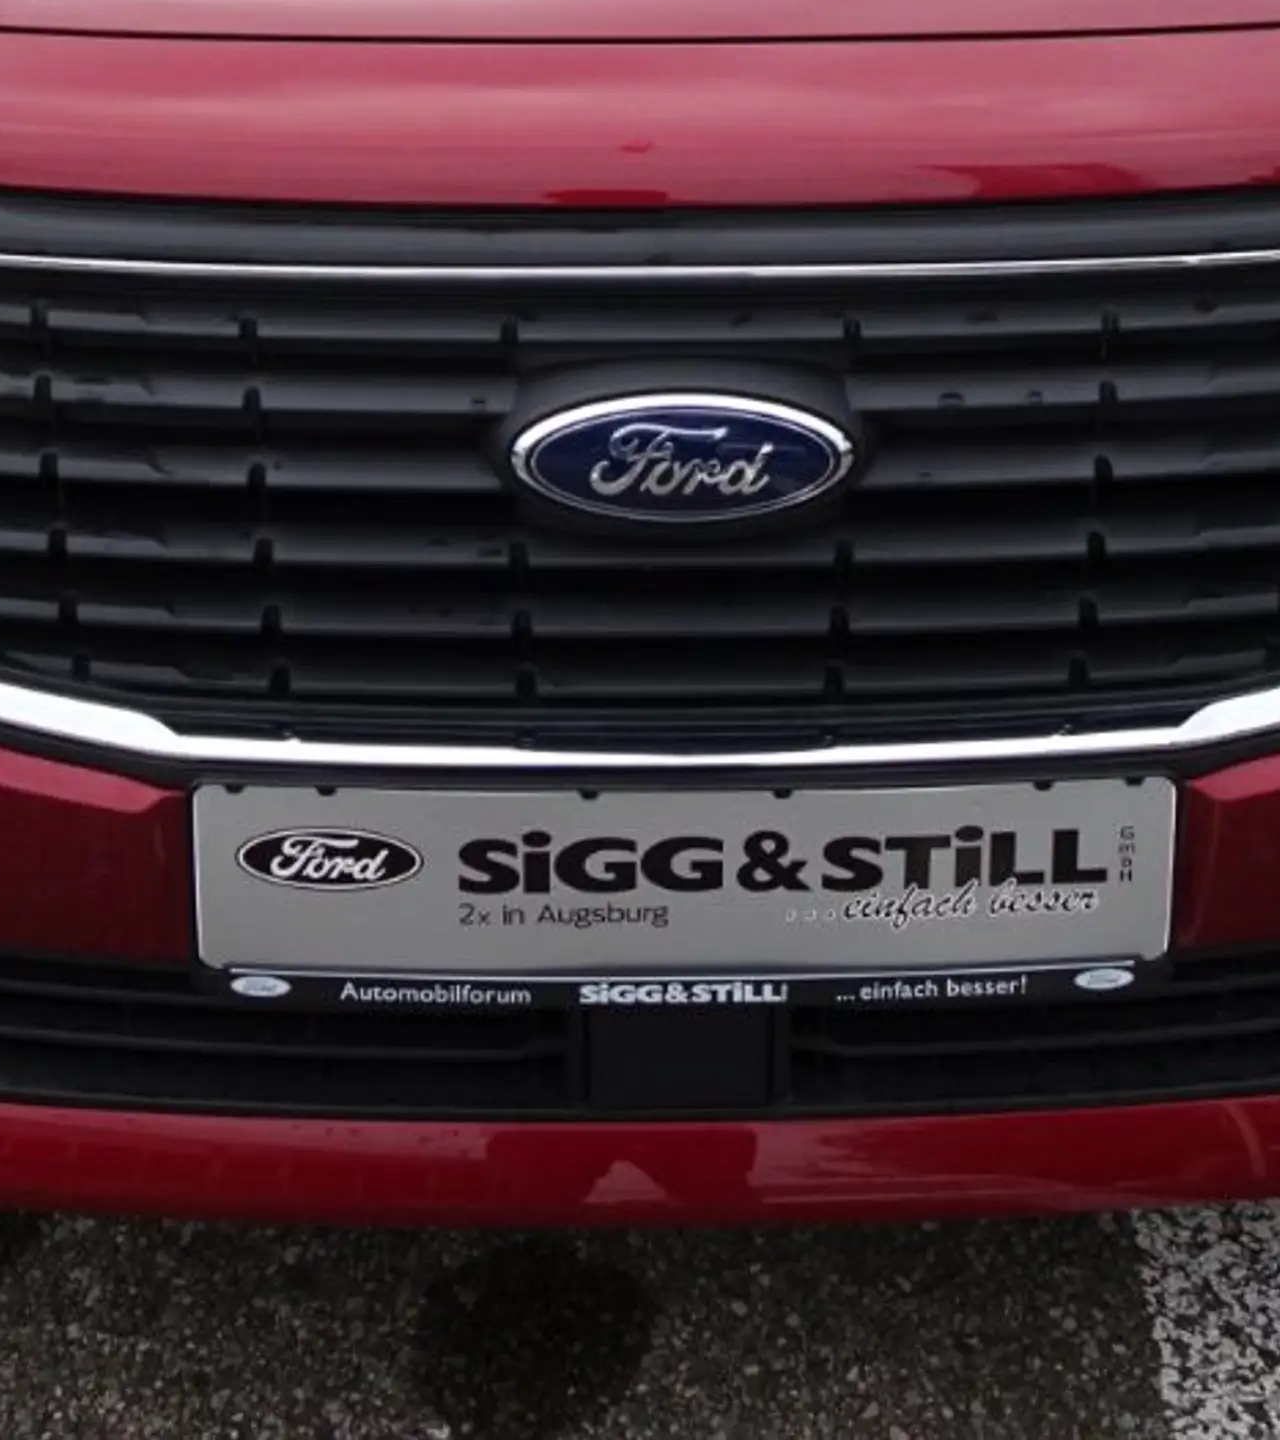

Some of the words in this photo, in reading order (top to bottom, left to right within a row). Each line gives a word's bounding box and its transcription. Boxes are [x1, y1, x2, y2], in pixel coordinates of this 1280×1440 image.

[589, 423, 774, 495] Ford
[270, 835, 386, 880] Ford
[458, 903, 490, 926] 2x
[502, 903, 524, 926] in
[537, 903, 669, 930] Augsburg
[988, 877, 1099, 917] besser
[340, 981, 532, 1005] Automobilforum
[946, 972, 1029, 997] besser!
